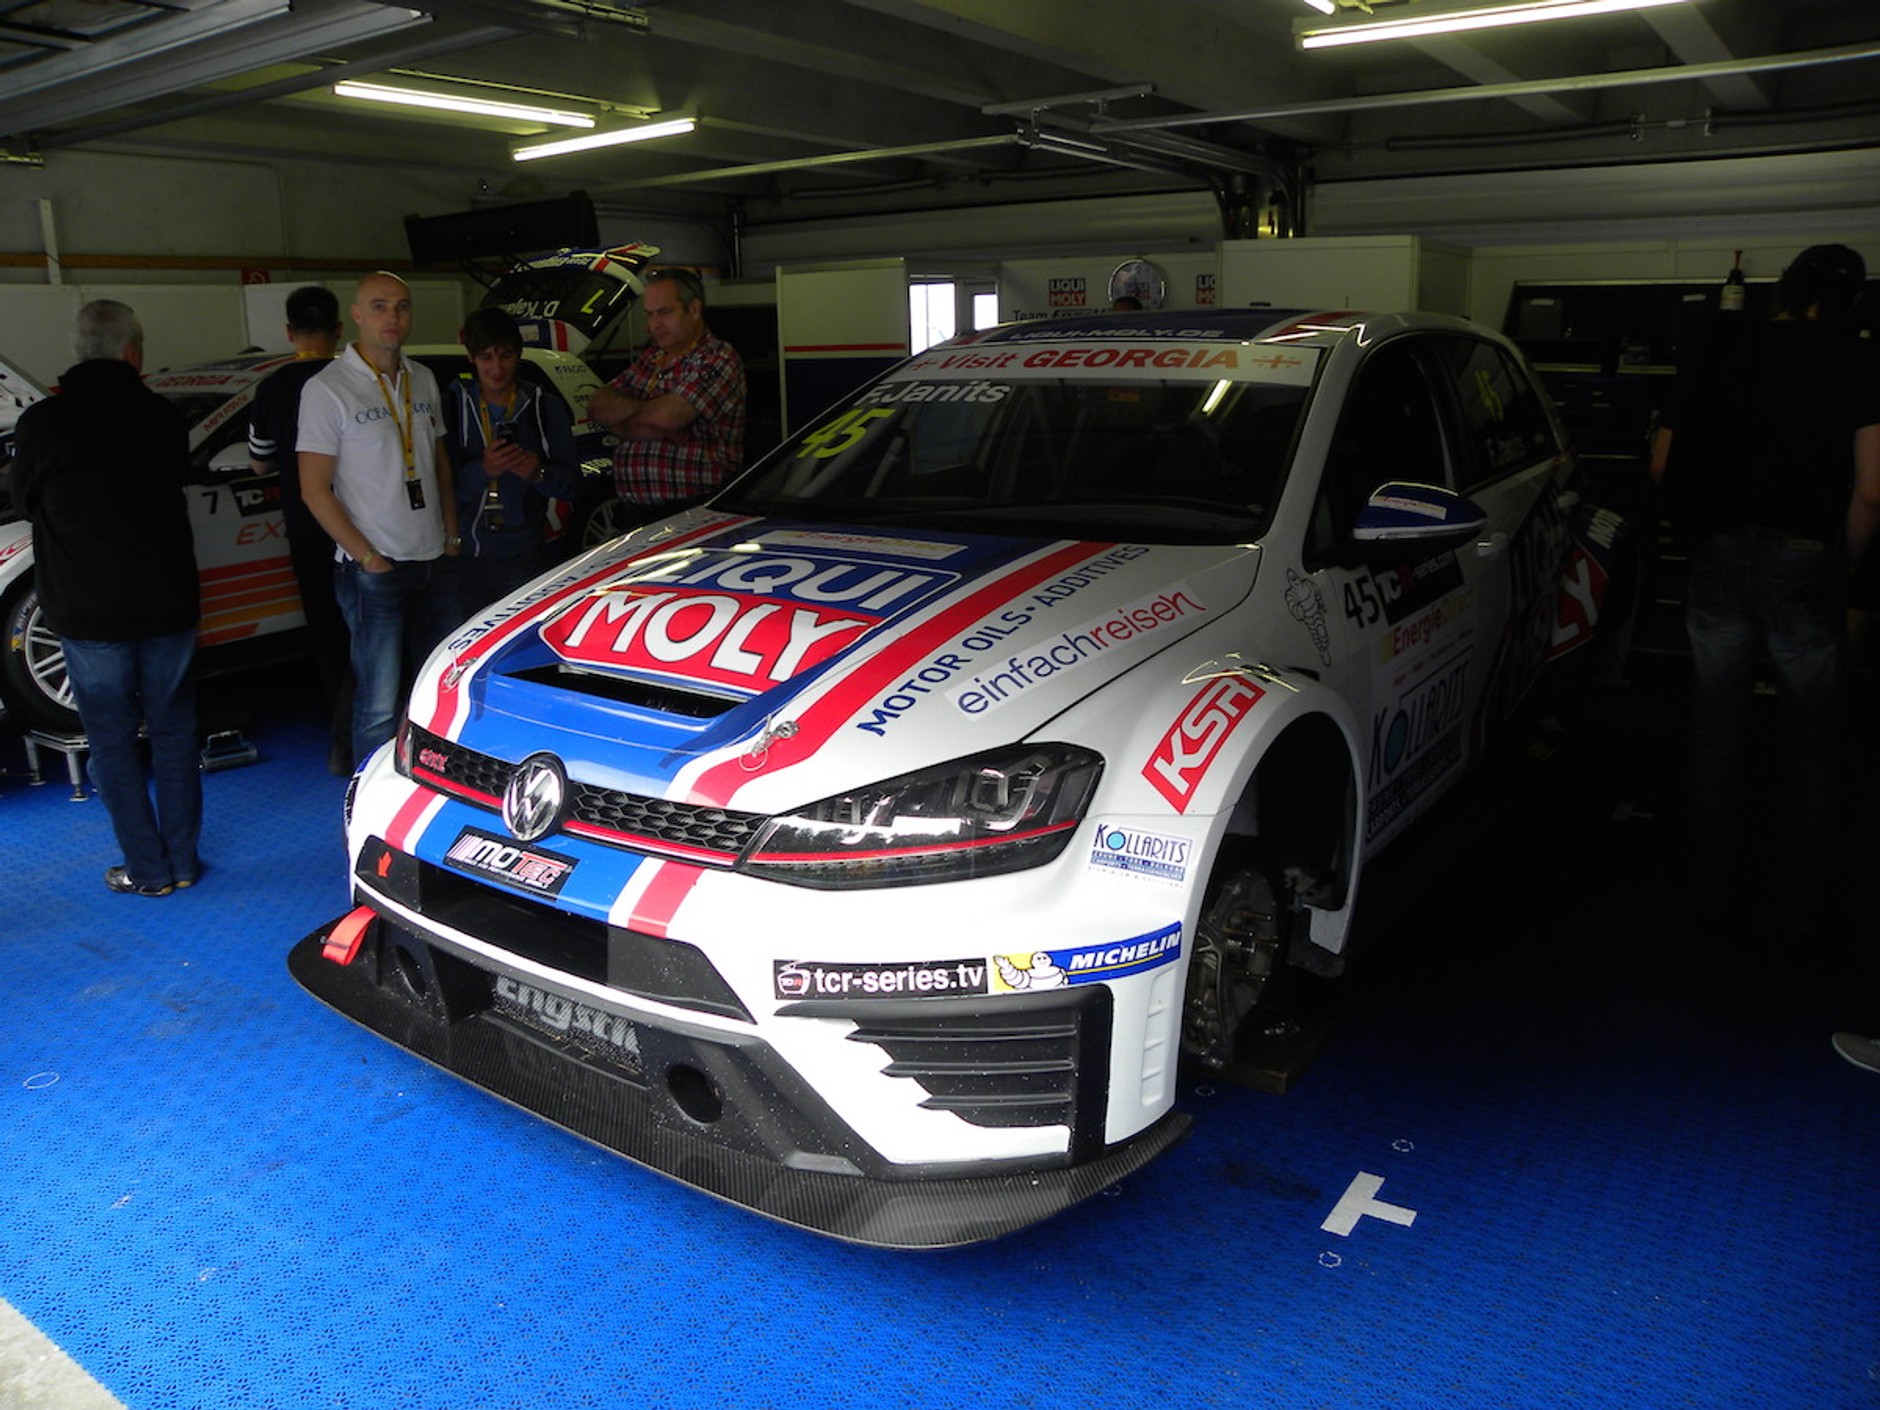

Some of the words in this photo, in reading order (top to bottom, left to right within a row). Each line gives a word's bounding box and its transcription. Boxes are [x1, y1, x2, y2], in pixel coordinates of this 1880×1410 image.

[579, 288, 605, 315] 7
[1051, 279, 1085, 291] LIQUI
[1051, 291, 1085, 305] MOLY
[937, 352, 1017, 370] Visit
[1023, 349, 1239, 369] GEORGIA
[796, 408, 897, 459] 45
[201, 491, 218, 514] 7
[652, 553, 933, 610] LIQUI
[1344, 575, 1379, 628] 45
[564, 590, 869, 682] MOLY
[856, 652, 973, 737] MOTOR
[1032, 544, 1150, 608] ADDITIVES
[957, 590, 1207, 715] einfachreisen
[1093, 823, 1187, 864] KOLLARITS
[1068, 931, 1181, 970] MICHELIN
[815, 963, 985, 993] tcr-series.tv
